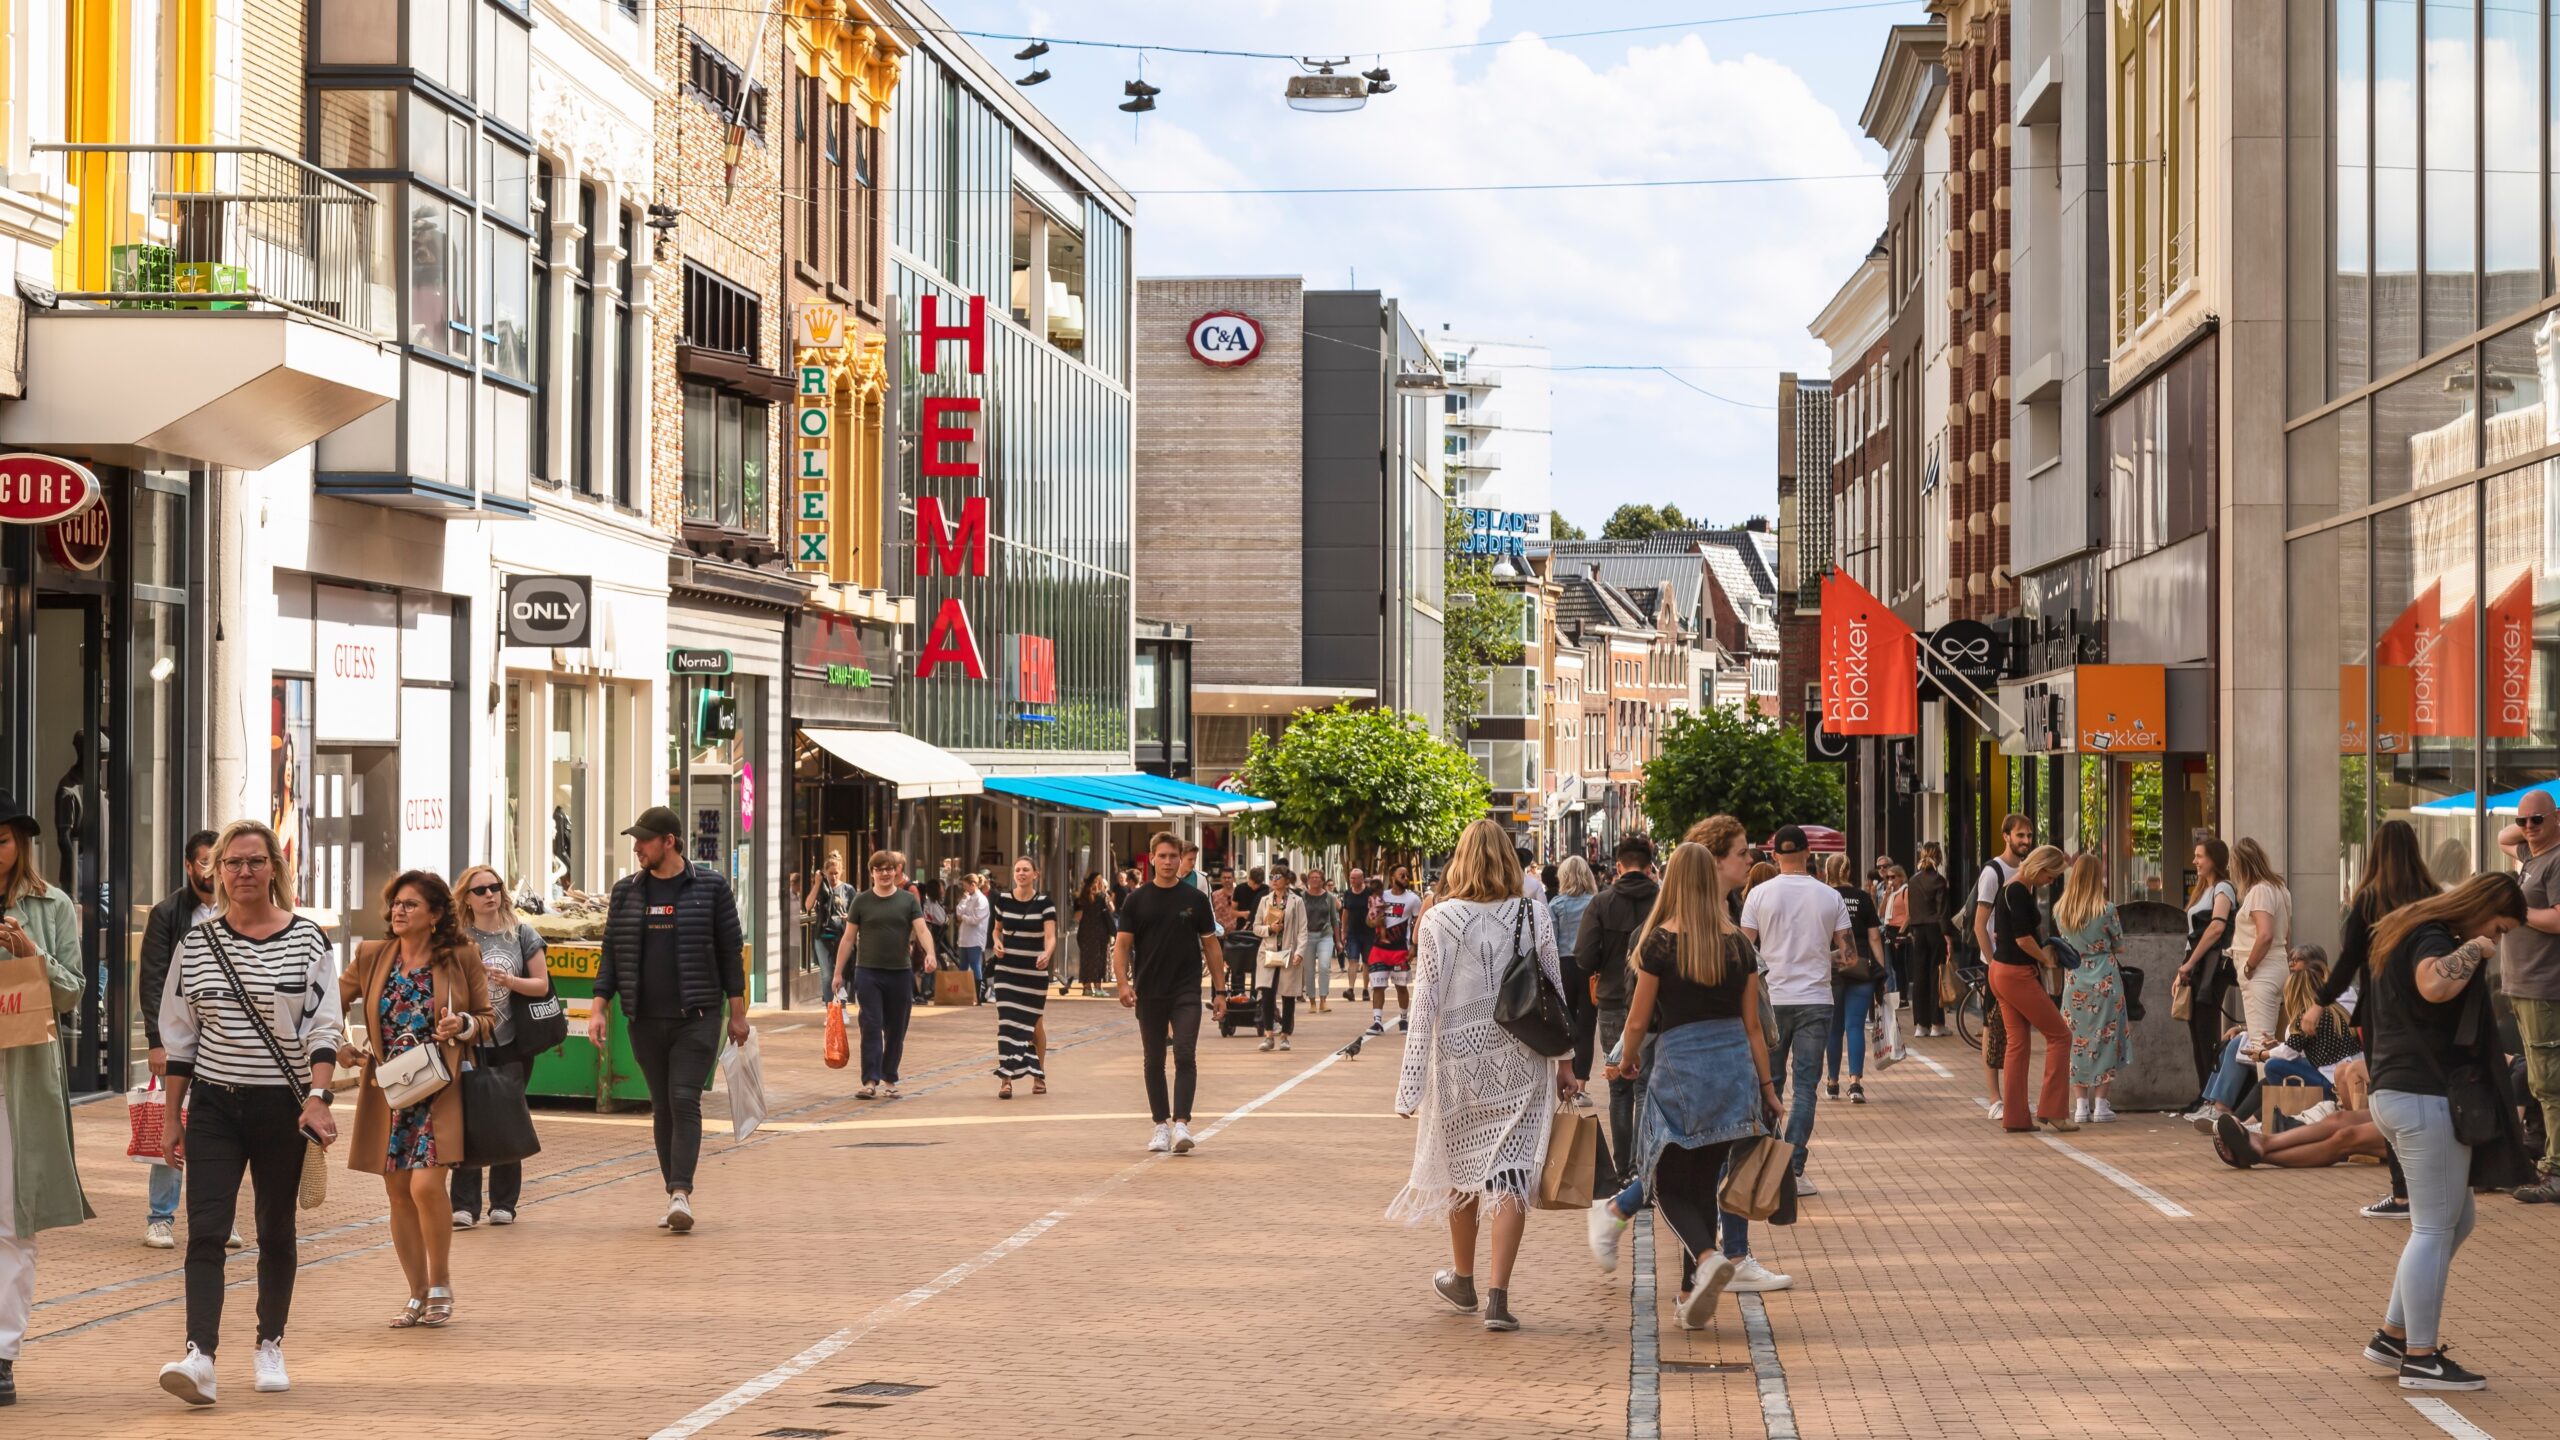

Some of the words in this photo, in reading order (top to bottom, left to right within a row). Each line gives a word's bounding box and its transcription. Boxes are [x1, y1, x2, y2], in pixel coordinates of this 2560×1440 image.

[1200, 326, 1250, 351] C&A
[801, 367, 828, 562] ROLEX
[916, 295, 989, 679] HEMA
[1459, 534, 1525, 556] ORDEN
[512, 600, 582, 622] ONLY
[334, 643, 376, 679] GUESS
[678, 652, 722, 669] Normal
[1019, 632, 1056, 705] HEMA
[718, 704, 735, 732] Normal
[406, 798, 443, 831] GUESS
